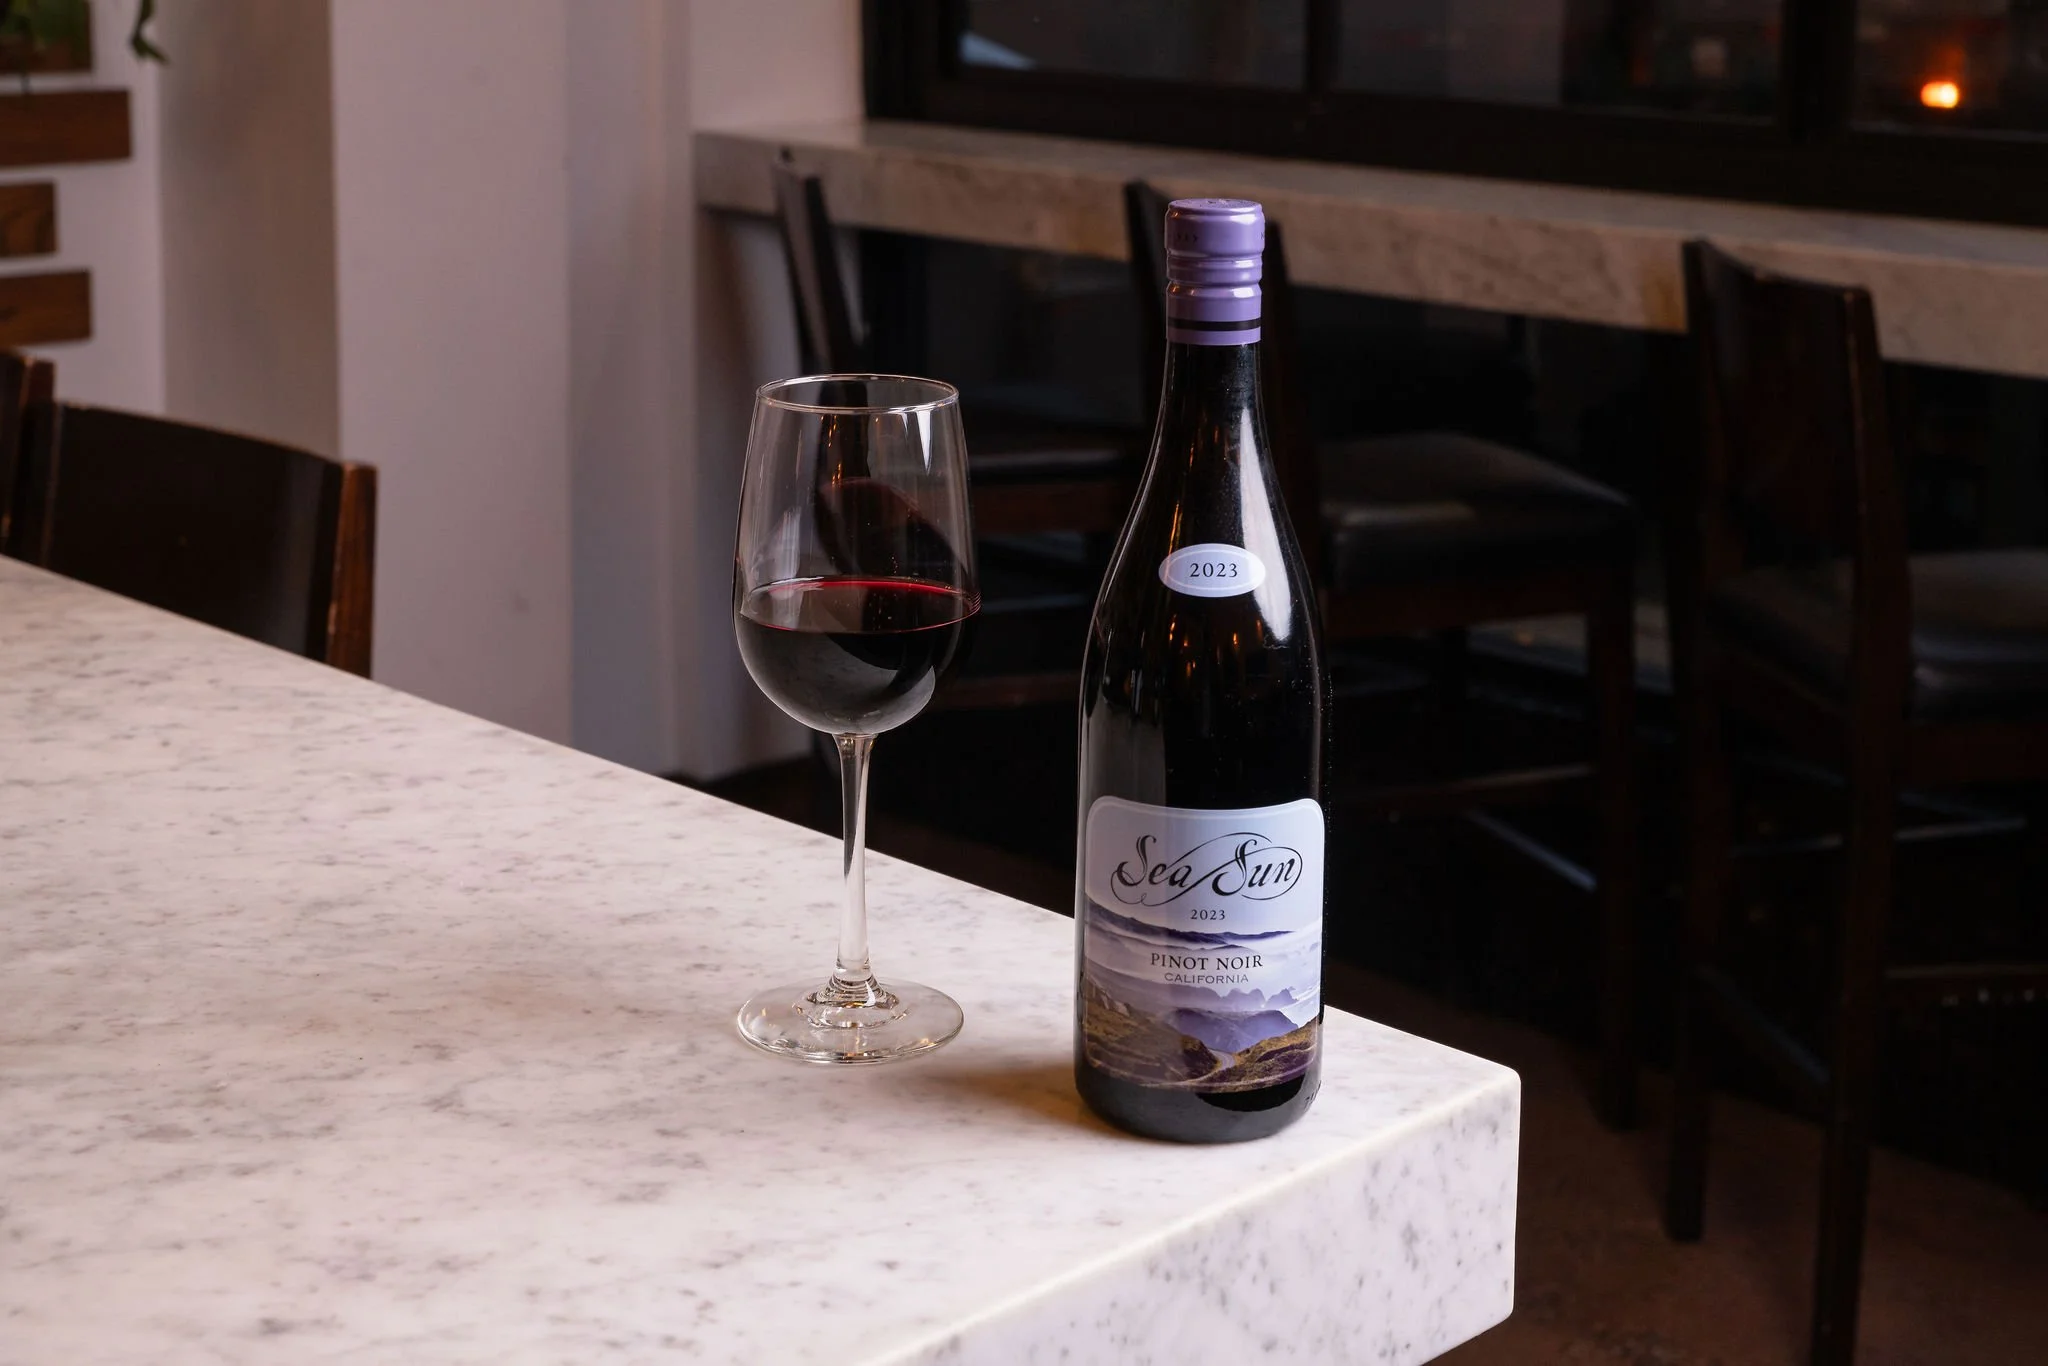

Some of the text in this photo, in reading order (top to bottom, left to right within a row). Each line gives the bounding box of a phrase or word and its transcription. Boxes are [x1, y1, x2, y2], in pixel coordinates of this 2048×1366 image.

[1189, 562, 1238, 578] 2023
[1112, 834, 1300, 899] Sea Sun
[1190, 909, 1226, 921] 2023
[1150, 952, 1264, 971] PINOT NOIR
[1164, 972, 1249, 985] CALIFORNIA
